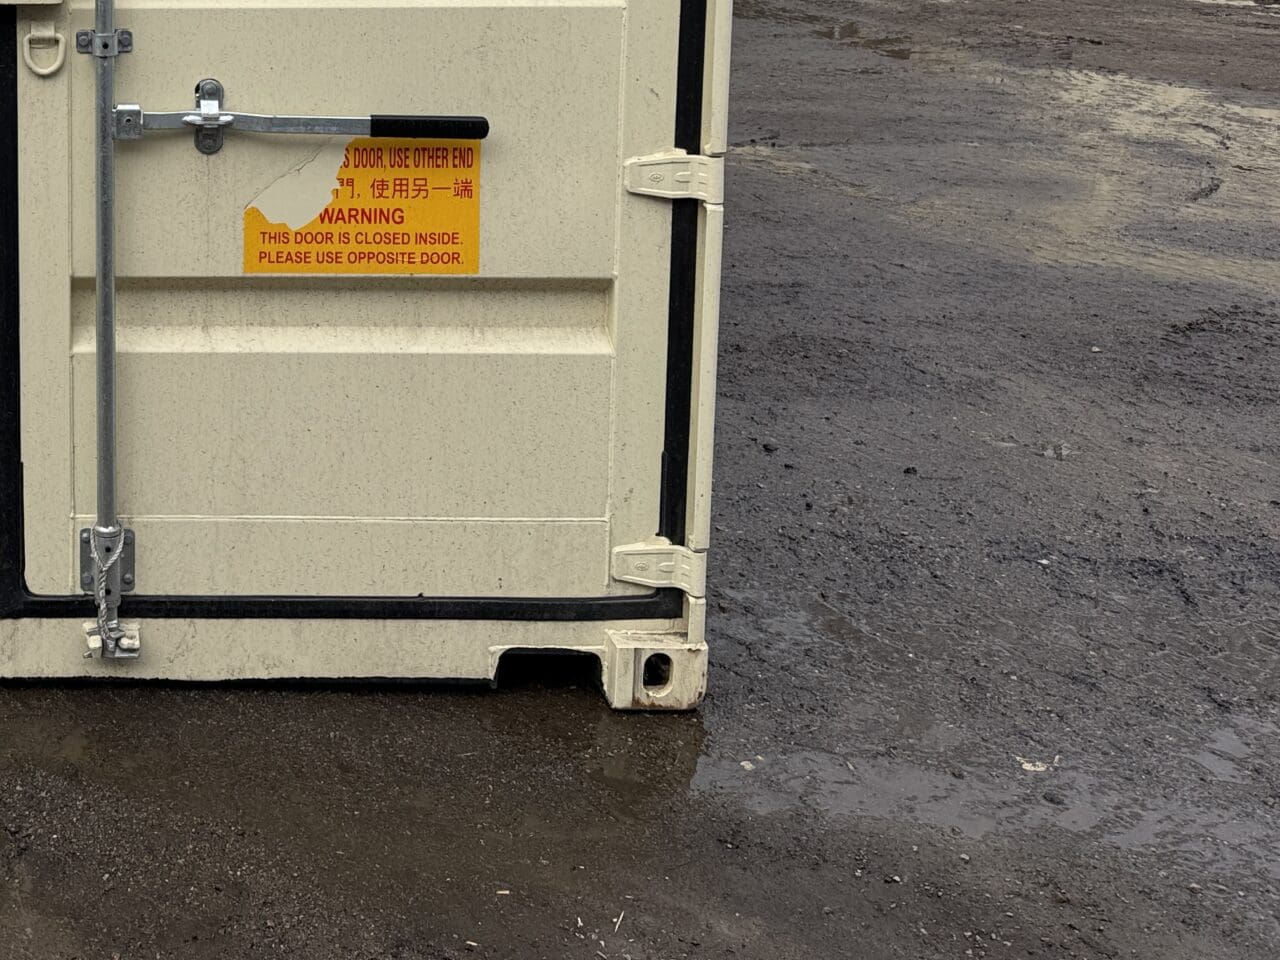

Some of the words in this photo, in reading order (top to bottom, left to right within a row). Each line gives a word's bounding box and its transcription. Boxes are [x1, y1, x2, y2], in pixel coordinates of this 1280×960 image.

[389, 147, 410, 169] USE
[413, 147, 449, 169] OTHER
[452, 147, 474, 169] END
[320, 207, 405, 225] WARNING
[260, 231, 290, 245] THIS
[294, 232, 334, 245] DOOR
[338, 232, 351, 245] IS
[355, 232, 410, 246] CLOSED
[415, 232, 464, 246] INSIDE.
[258, 251, 312, 265] PLEASE
[316, 251, 343, 265] USE
[349, 251, 416, 265] OPPOSITE
[420, 251, 464, 265] DOOR.
